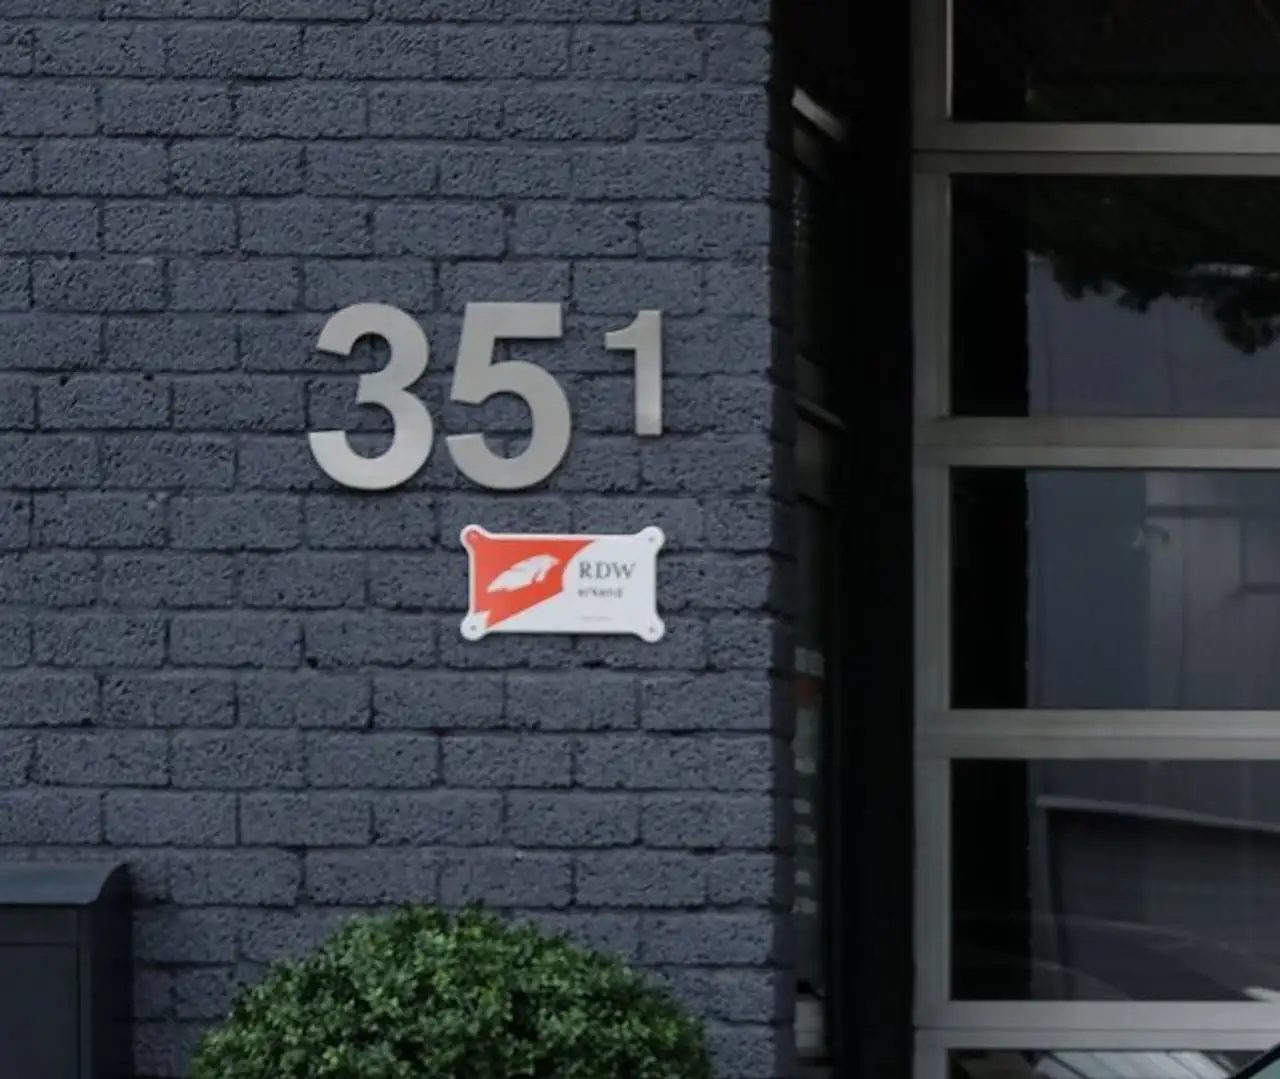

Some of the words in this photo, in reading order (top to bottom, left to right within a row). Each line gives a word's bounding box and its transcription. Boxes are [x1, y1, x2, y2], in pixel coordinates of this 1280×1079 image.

[307, 301, 573, 491] 35
[603, 309, 663, 436] 1
[579, 560, 636, 580] RDW
